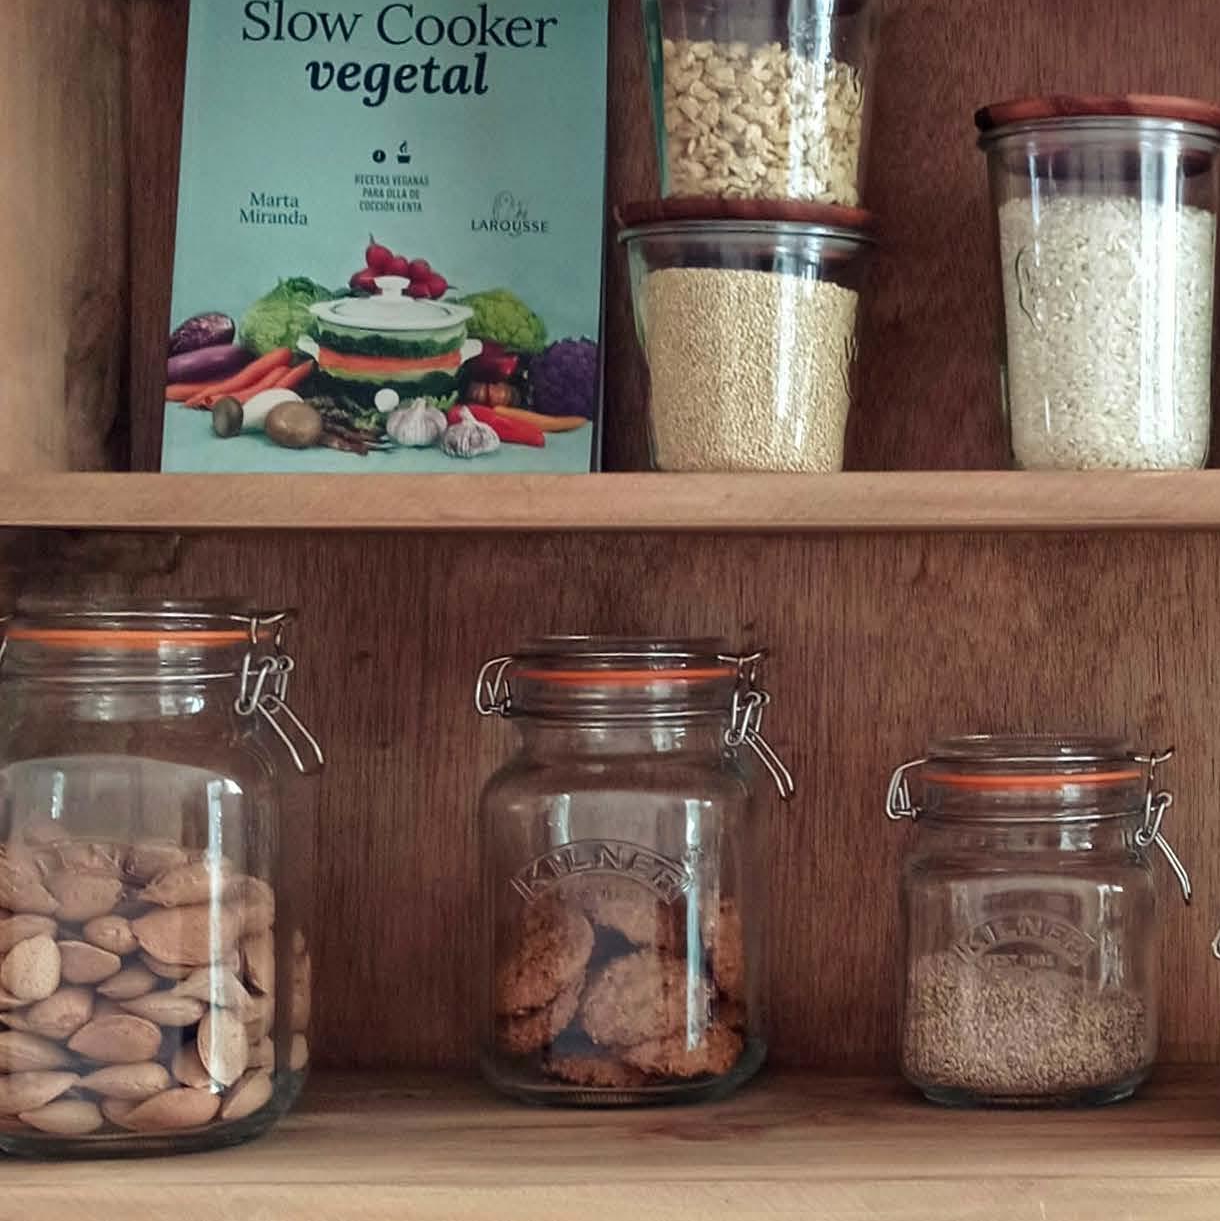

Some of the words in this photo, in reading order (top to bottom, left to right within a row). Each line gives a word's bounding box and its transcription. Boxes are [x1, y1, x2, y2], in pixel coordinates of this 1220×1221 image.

[376, 3, 558, 48] Cooker
[305, 52, 489, 108] vegetal
[354, 174, 389, 185] RECETAS
[391, 174, 430, 186] VEGANAS
[249, 192, 299, 208] Marta
[362, 188, 385, 198] PARA
[239, 208, 308, 225] Miranda
[471, 219, 549, 234] LAROUSSE
[510, 844, 677, 904] KILNER
